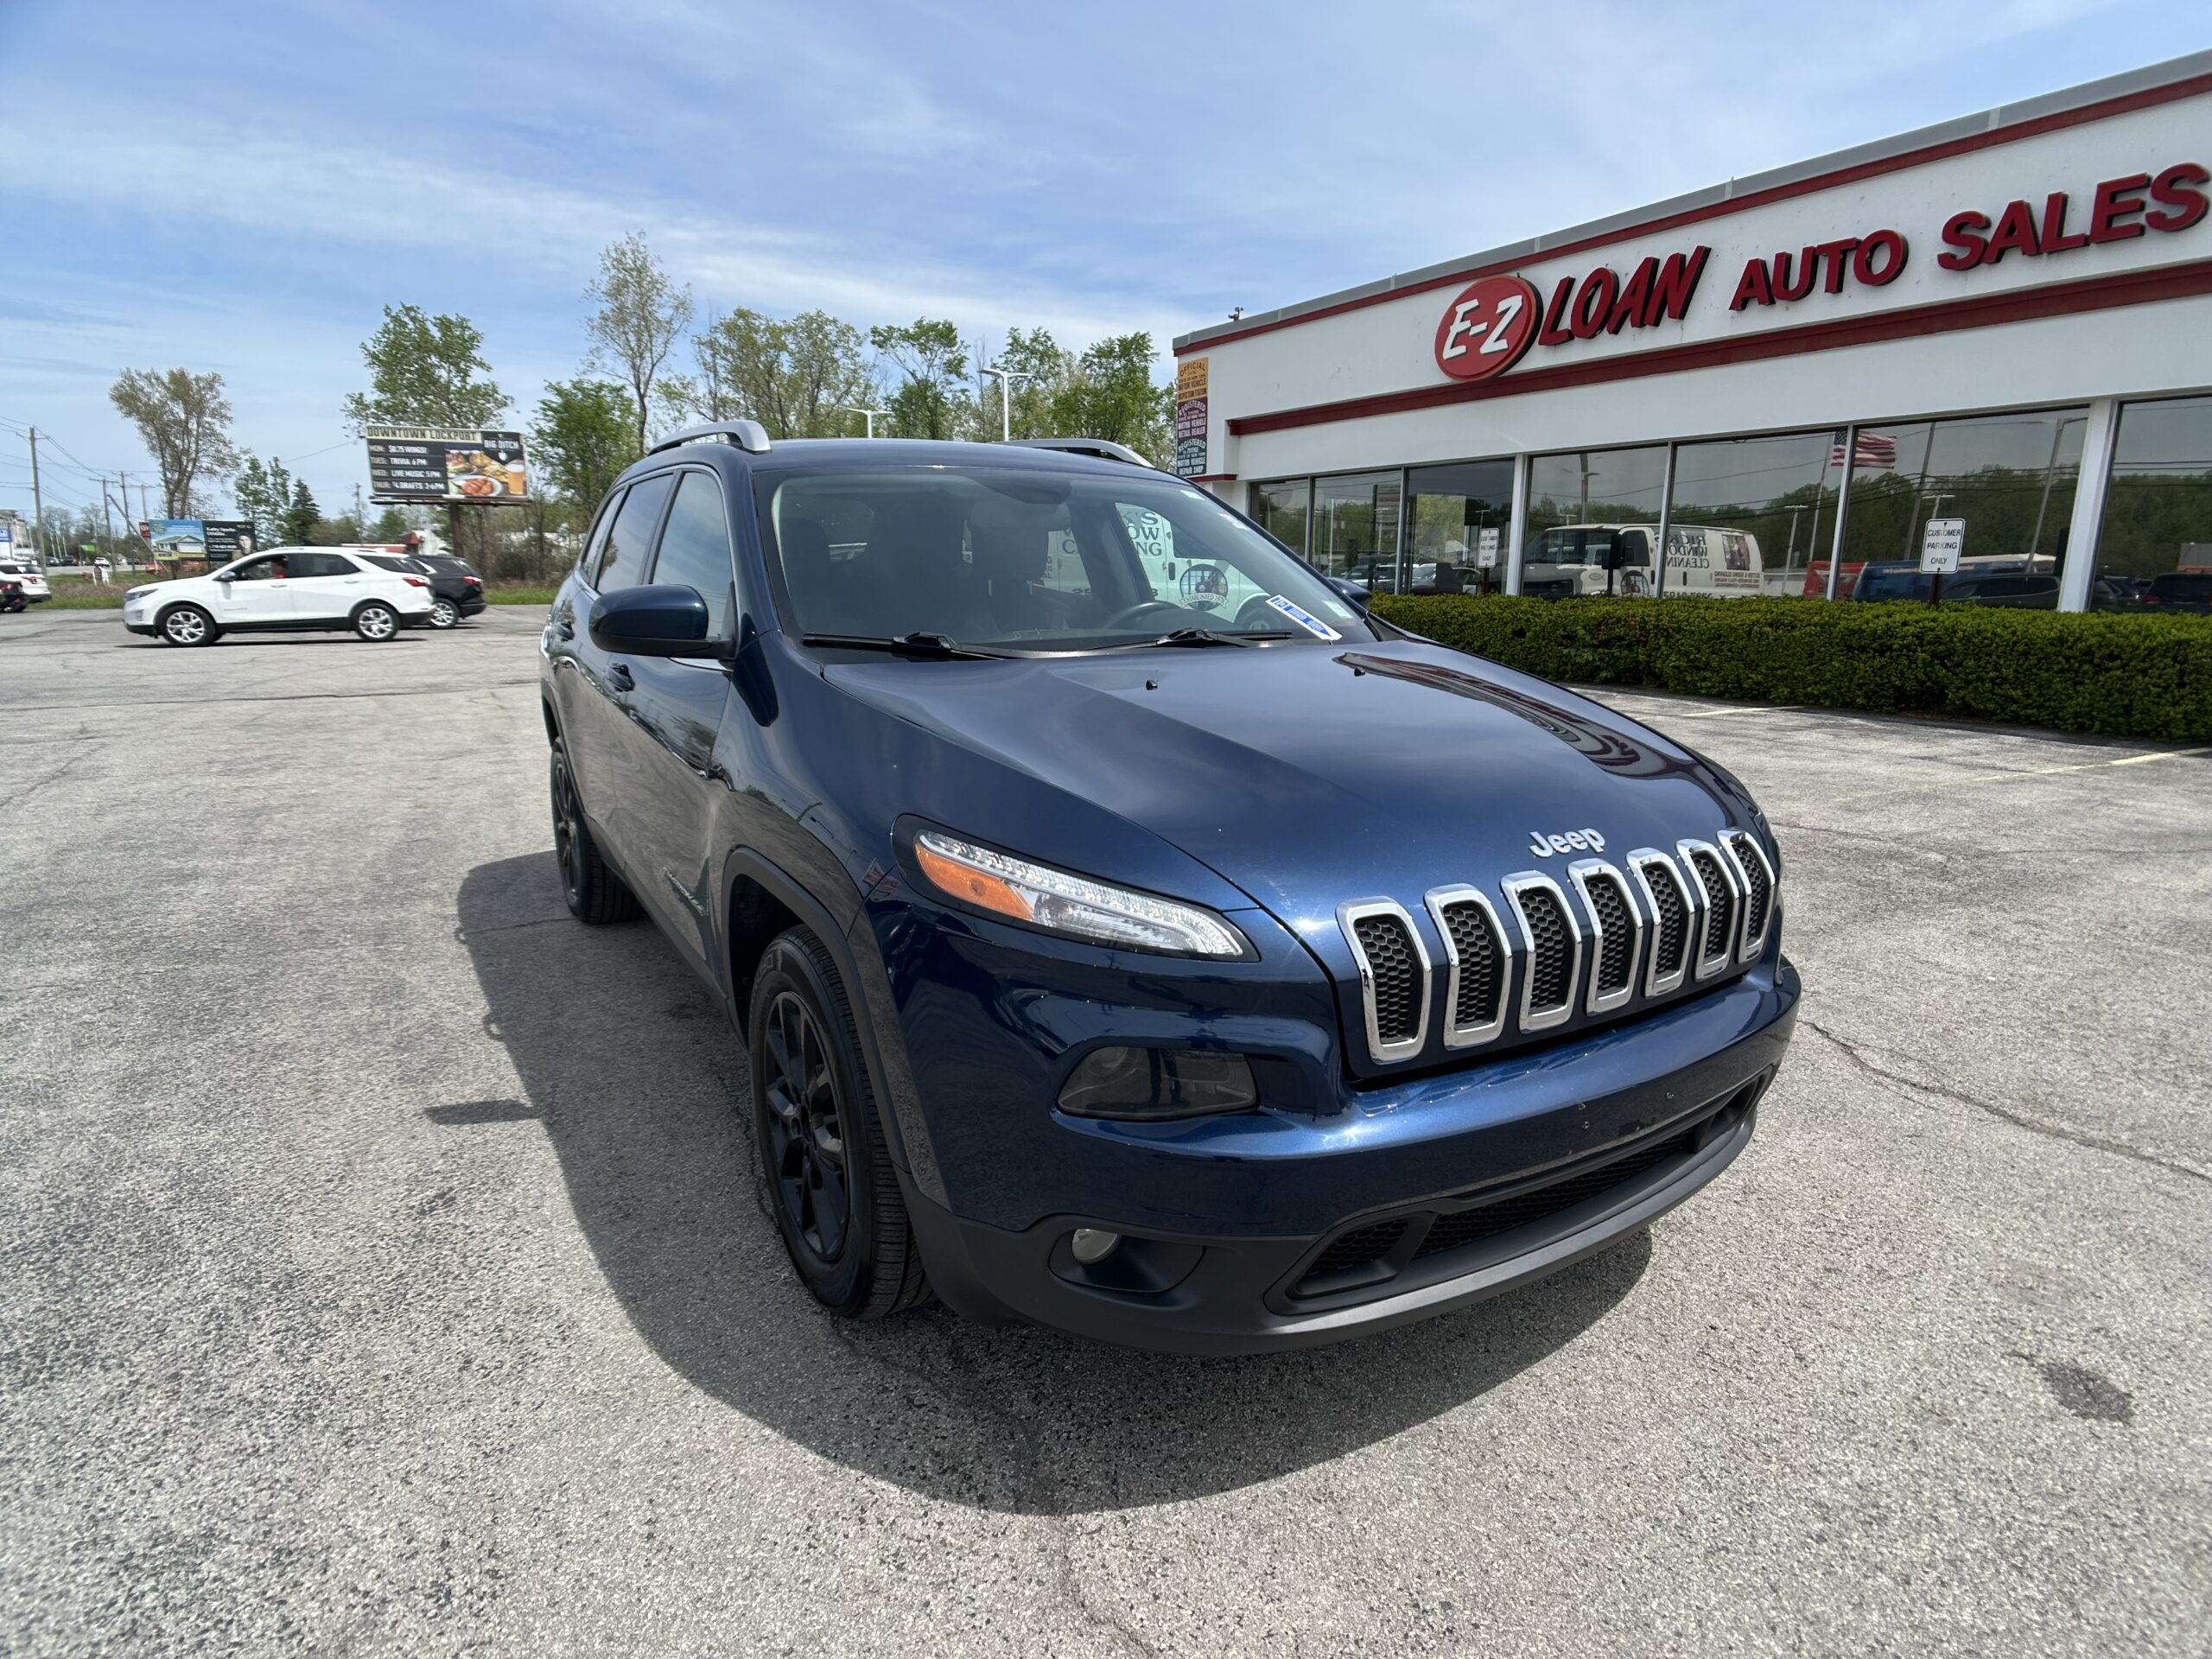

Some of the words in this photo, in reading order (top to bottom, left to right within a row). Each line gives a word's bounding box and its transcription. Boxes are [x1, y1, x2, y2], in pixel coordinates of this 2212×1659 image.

[1443, 295, 1523, 360] E-Z
[1538, 245, 1712, 346] LOAN
[1729, 229, 1910, 310] AUTO
[1937, 162, 2210, 271] SALES
[1179, 361, 1206, 377] OFFICIAL
[1192, 378, 1206, 387] VEHICLE
[1179, 400, 1206, 416] REGISTERED
[1192, 417, 1206, 427] VEHICLE
[367, 427, 427, 439] DOWNTOWN
[429, 429, 476, 441] LOCKPORT
[484, 439, 497, 448] BIG
[498, 440, 518, 449] DITCH
[1178, 438, 1206, 454] REGISTERED
[1191, 456, 1206, 466] VEHICLE
[1529, 828, 1605, 858] Jeep
